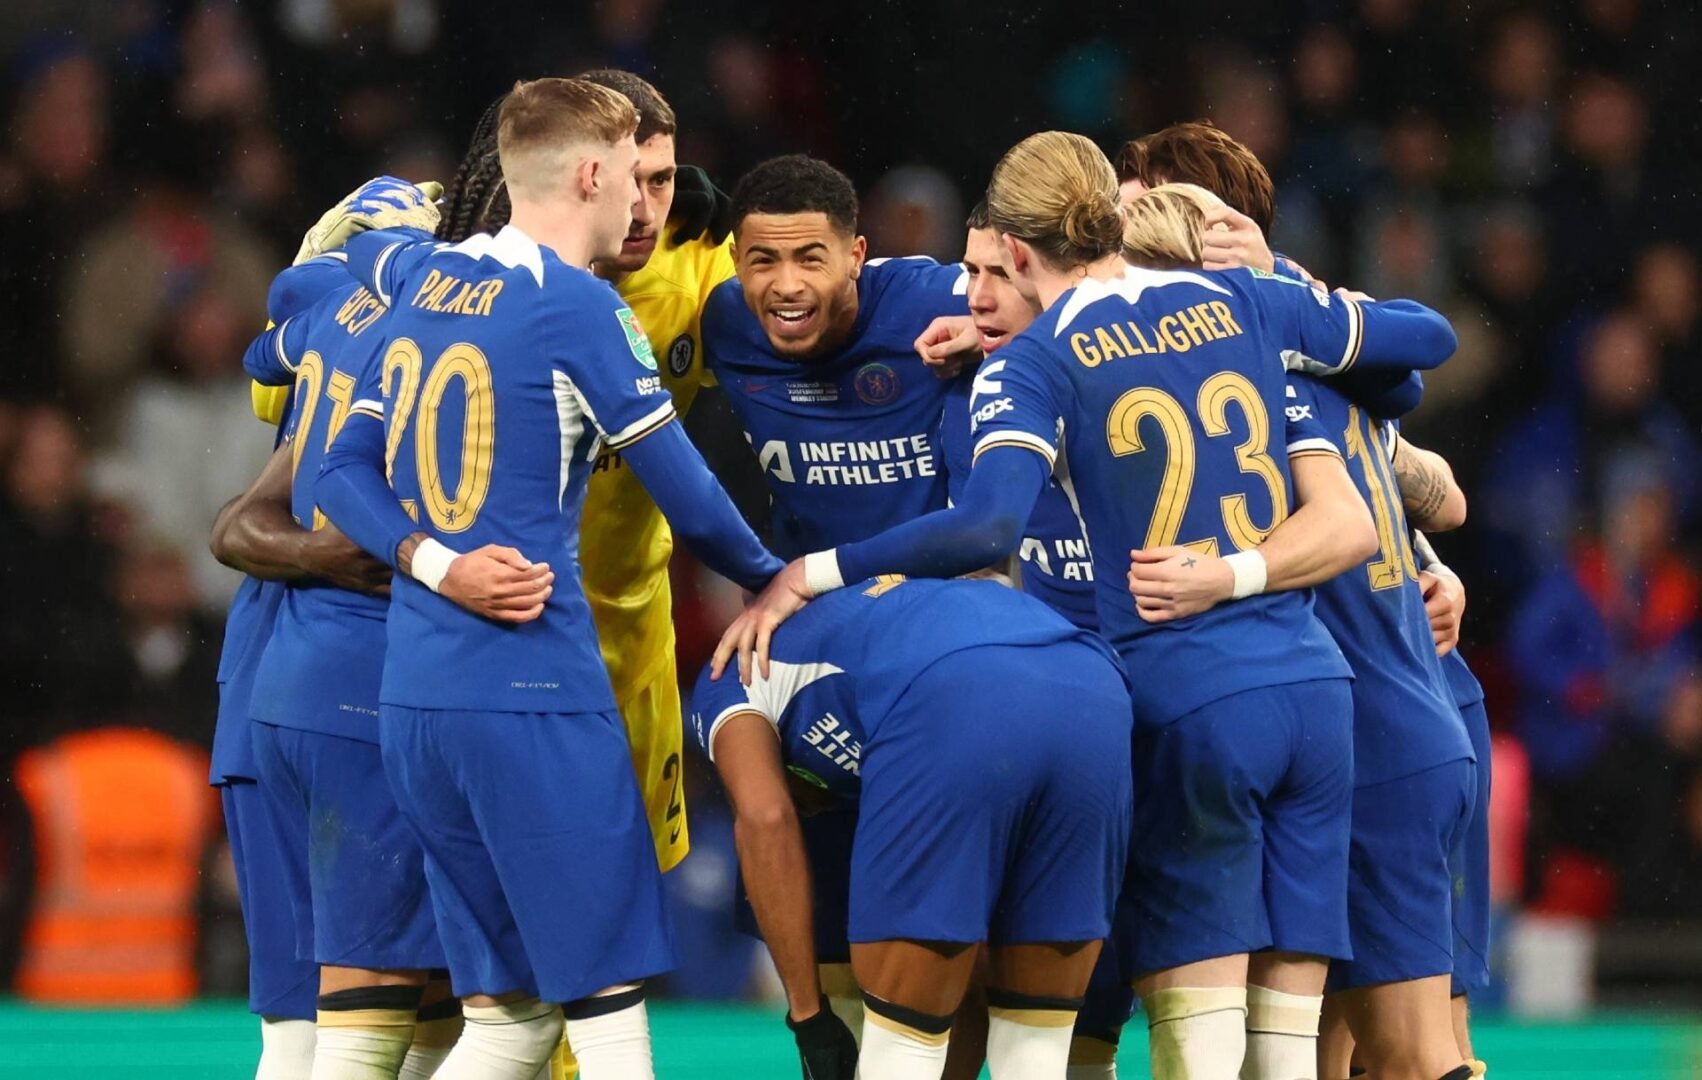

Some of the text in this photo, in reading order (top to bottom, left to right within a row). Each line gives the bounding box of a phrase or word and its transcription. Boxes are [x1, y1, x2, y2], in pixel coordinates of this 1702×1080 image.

[334, 286, 389, 338] GUST
[381, 337, 494, 534] 20
[799, 433, 931, 462] INFINITE
[806, 455, 936, 485] ATHLETE
[1106, 370, 1289, 560] 23
